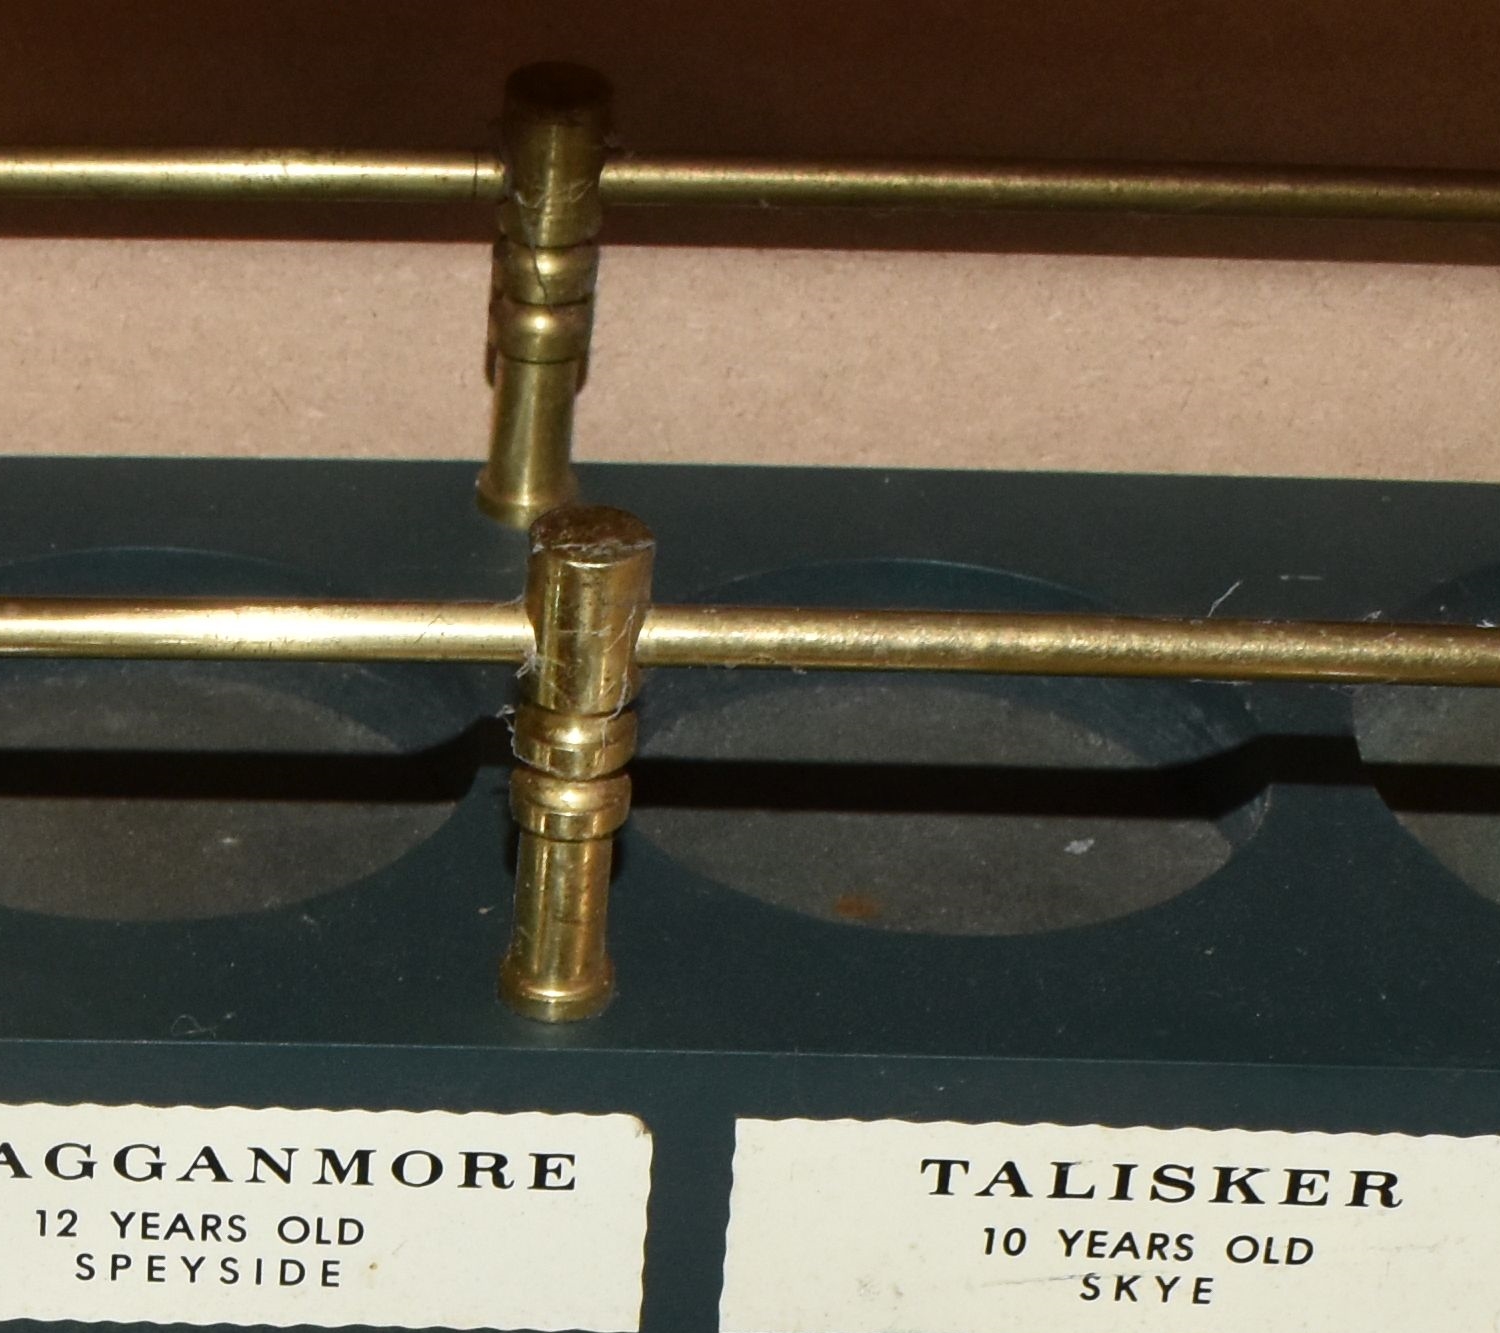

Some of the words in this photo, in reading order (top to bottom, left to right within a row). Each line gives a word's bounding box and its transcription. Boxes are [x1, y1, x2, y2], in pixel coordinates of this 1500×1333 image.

[920, 1158, 1403, 1209] TALISKER
[36, 1209, 78, 1237] 12
[110, 1211, 247, 1243] YEARS
[277, 1215, 364, 1246] OLD
[984, 1227, 1027, 1257] 10
[1058, 1228, 1194, 1262] YEARS
[1226, 1235, 1314, 1265] OLD
[75, 1253, 340, 1288] SPEYSIDE
[1080, 1272, 1214, 1305] SKYE
